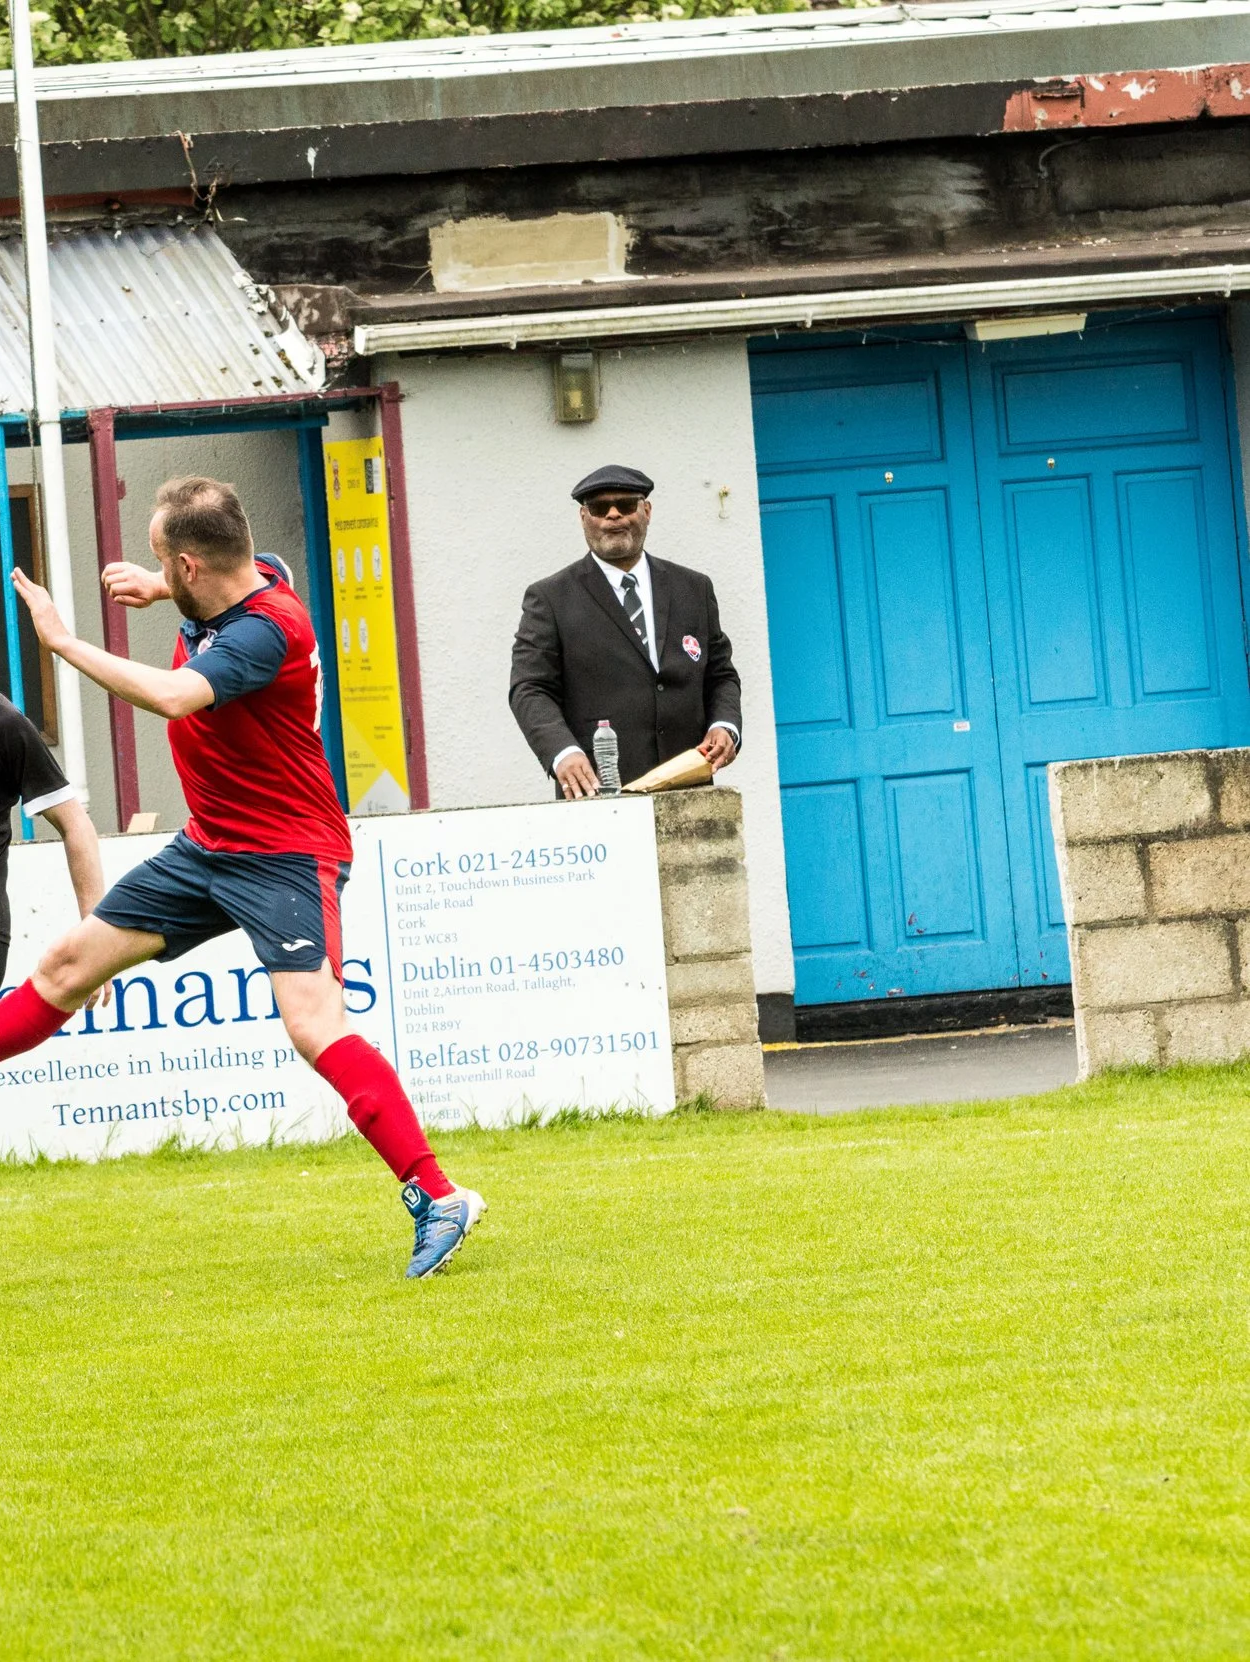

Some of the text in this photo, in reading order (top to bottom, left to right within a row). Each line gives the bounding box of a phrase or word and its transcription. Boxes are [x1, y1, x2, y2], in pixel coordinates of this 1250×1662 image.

[394, 843, 607, 878] Cork 021-2455500
[396, 869, 595, 895] Unit 2, Touchdown Business Park
[397, 896, 473, 912] Kinsale Road
[398, 916, 425, 929] Cork
[399, 933, 457, 947] T12 WC83
[402, 947, 624, 982] Dublin 01-4503480
[404, 989, 428, 999] Unit
[486, 979, 519, 992] Road,
[522, 976, 576, 991] Tallaght,
[405, 1004, 444, 1016] Dublin
[406, 1023, 427, 1033] D24
[127, 1054, 152, 1075] in
[160, 1046, 264, 1072] building
[409, 1043, 490, 1069] Belfast
[498, 1031, 659, 1061] 028-90731501
[410, 1065, 535, 1086] 46-64 Ravenhill Road
[52, 1089, 286, 1127] Tennantsbp.com
[411, 1091, 450, 1104] Belfast
